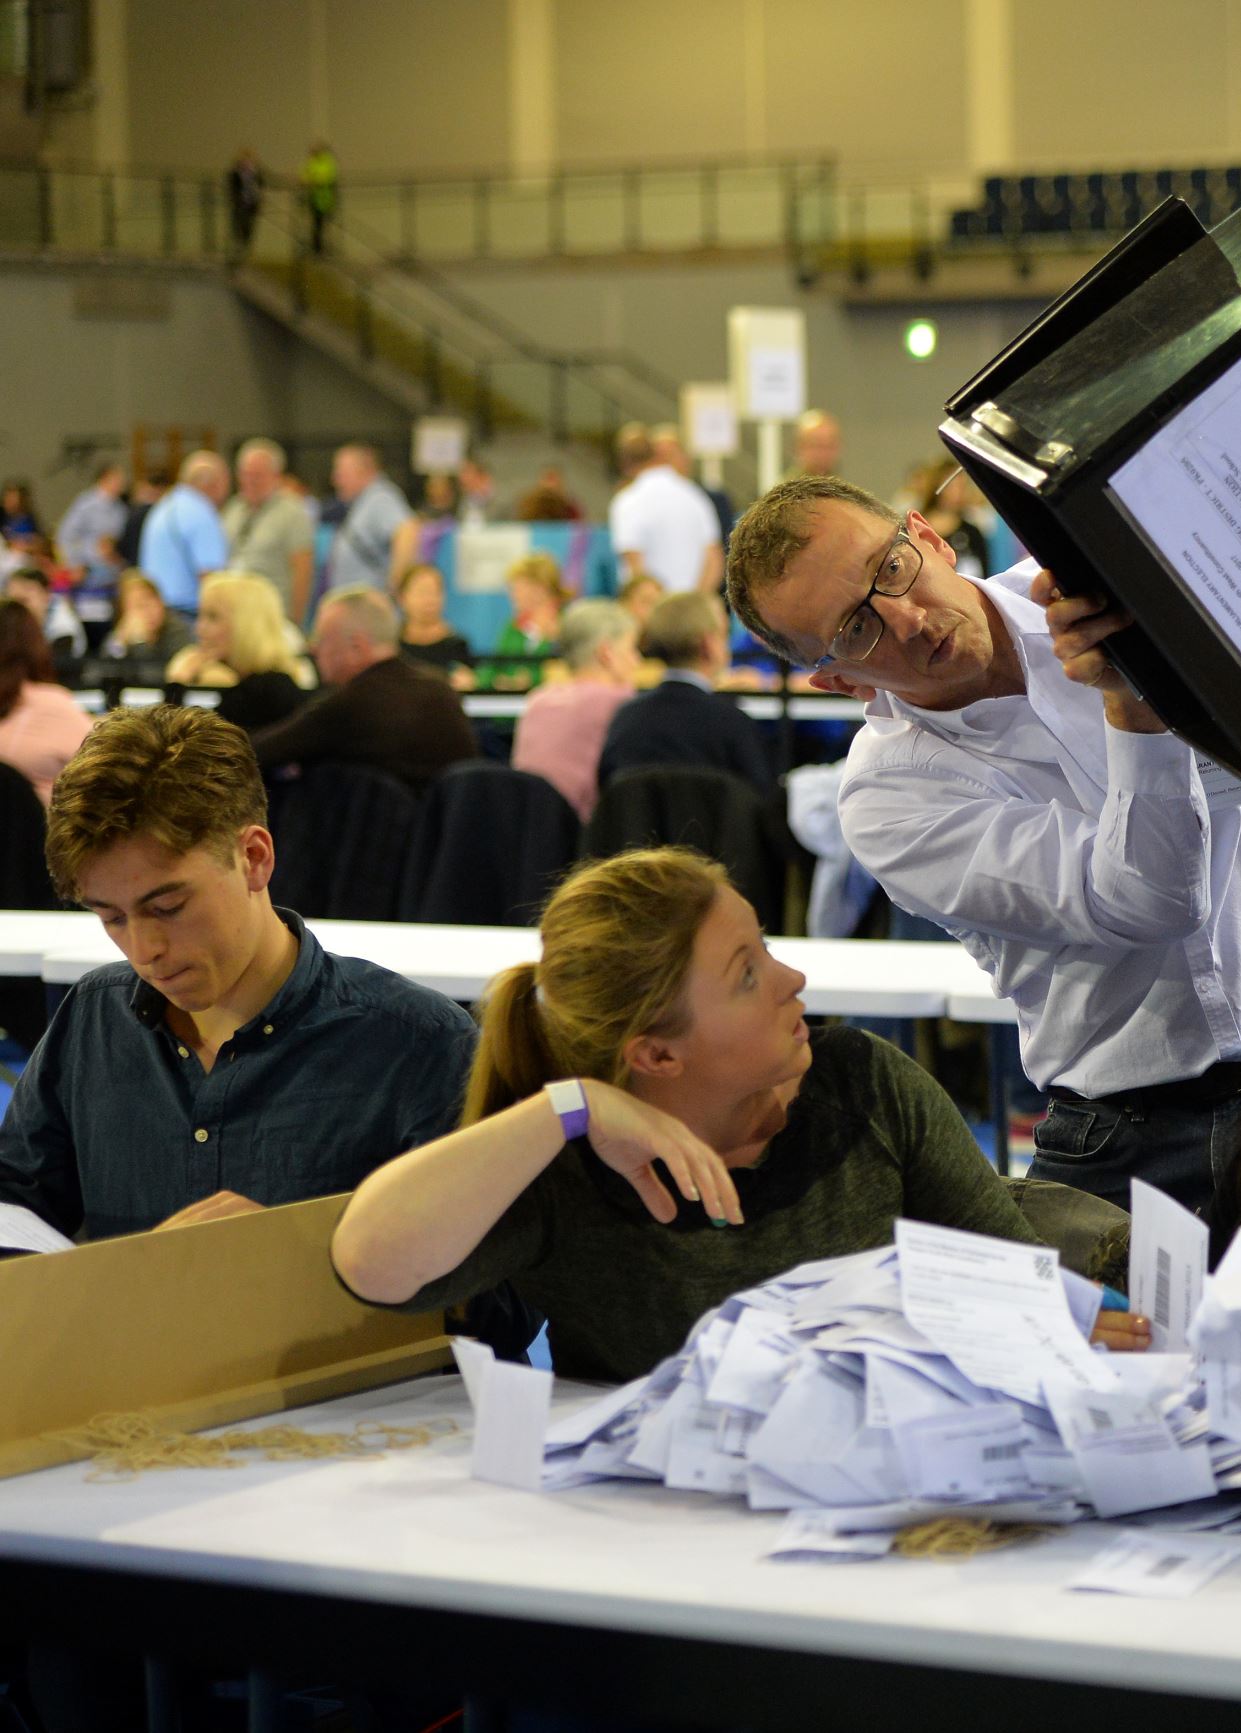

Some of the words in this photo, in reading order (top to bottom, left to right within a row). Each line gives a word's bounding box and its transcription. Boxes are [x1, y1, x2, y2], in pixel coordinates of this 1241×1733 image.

[1221, 453, 1241, 477] School
[1205, 489, 1237, 528] DISTRICT
[1181, 550, 1209, 583] ELECTION
[1190, 532, 1225, 575] Constituency
[1222, 573, 1237, 590] West
